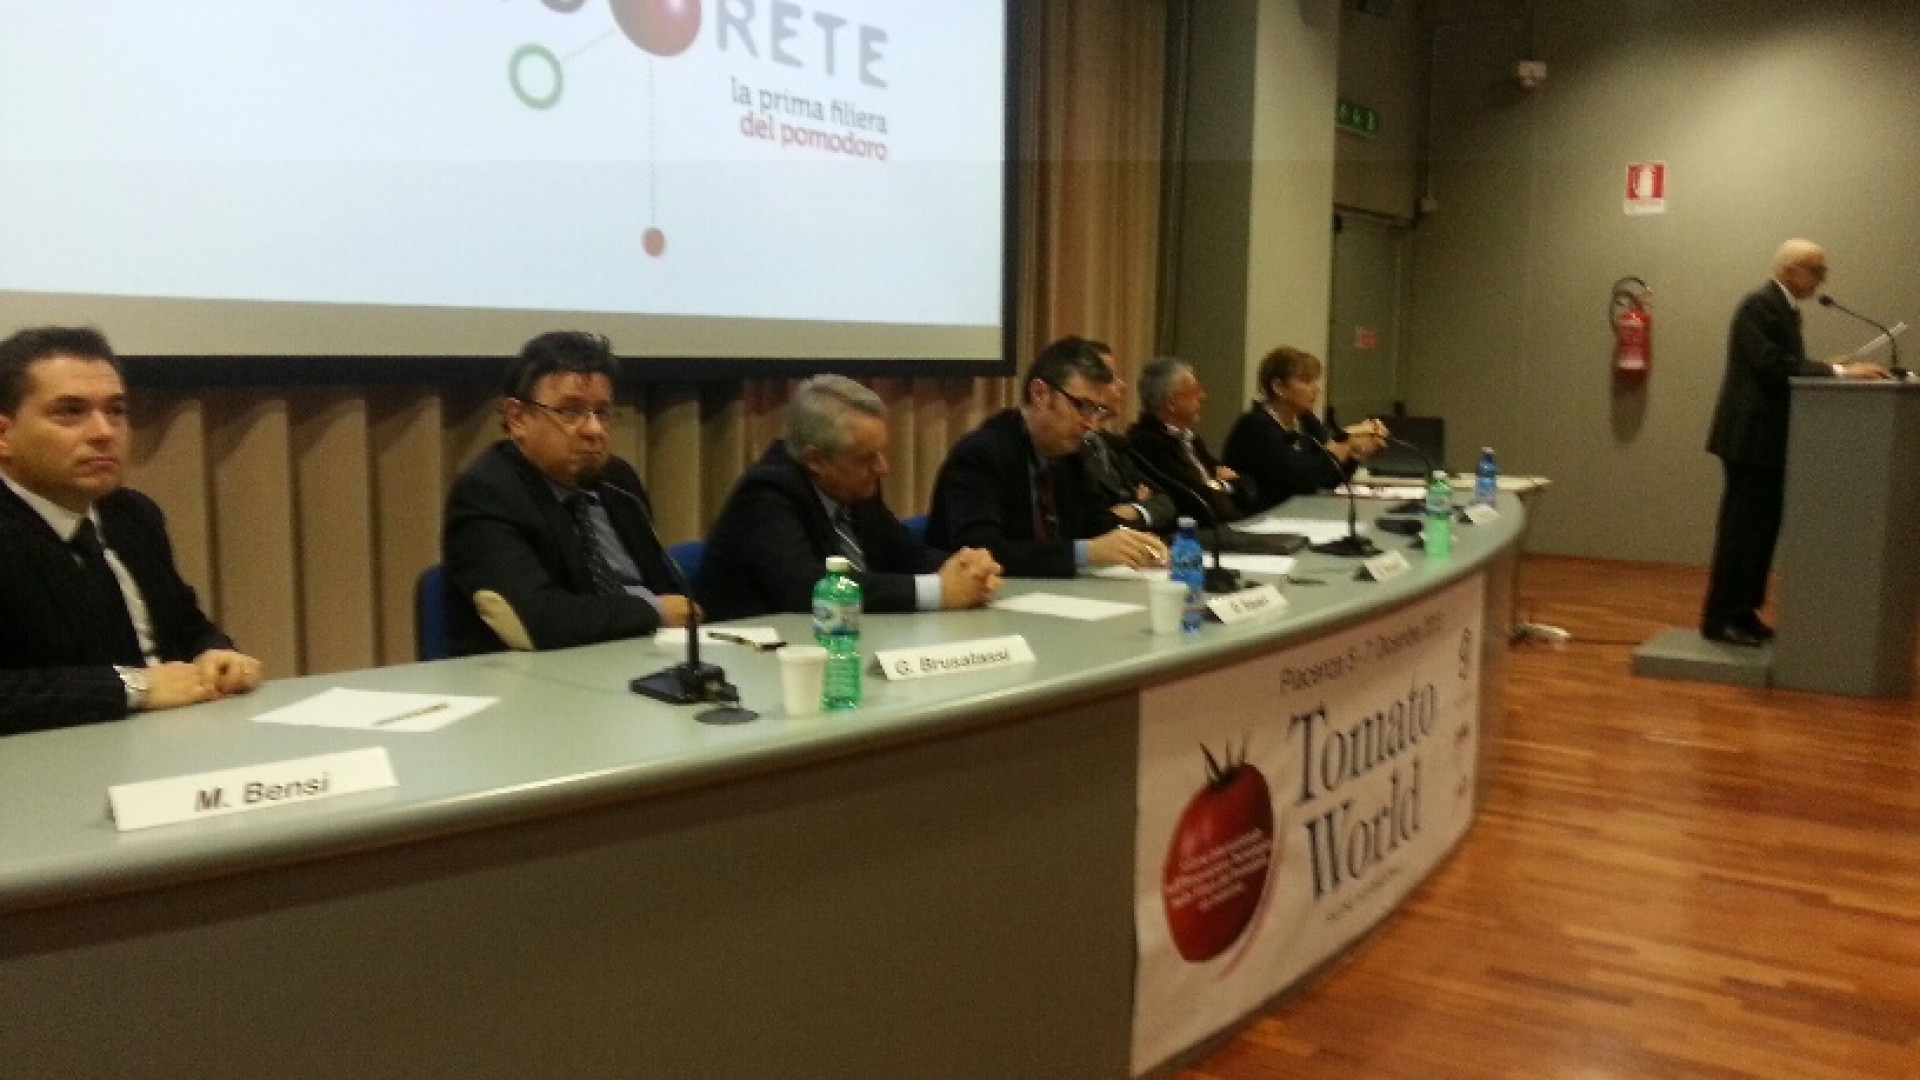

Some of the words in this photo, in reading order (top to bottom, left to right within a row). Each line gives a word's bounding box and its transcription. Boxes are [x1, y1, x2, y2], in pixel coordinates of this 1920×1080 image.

[717, 0, 888, 88] RETE
[731, 76, 752, 105] la
[760, 89, 825, 120] prima
[831, 99, 888, 134] filiera
[740, 111, 775, 140] del
[782, 124, 888, 161] pomodoro
[1290, 680, 1438, 806] Tomato
[194, 787, 231, 812] M.
[243, 772, 331, 805] Bensi
[1303, 758, 1422, 900] World
